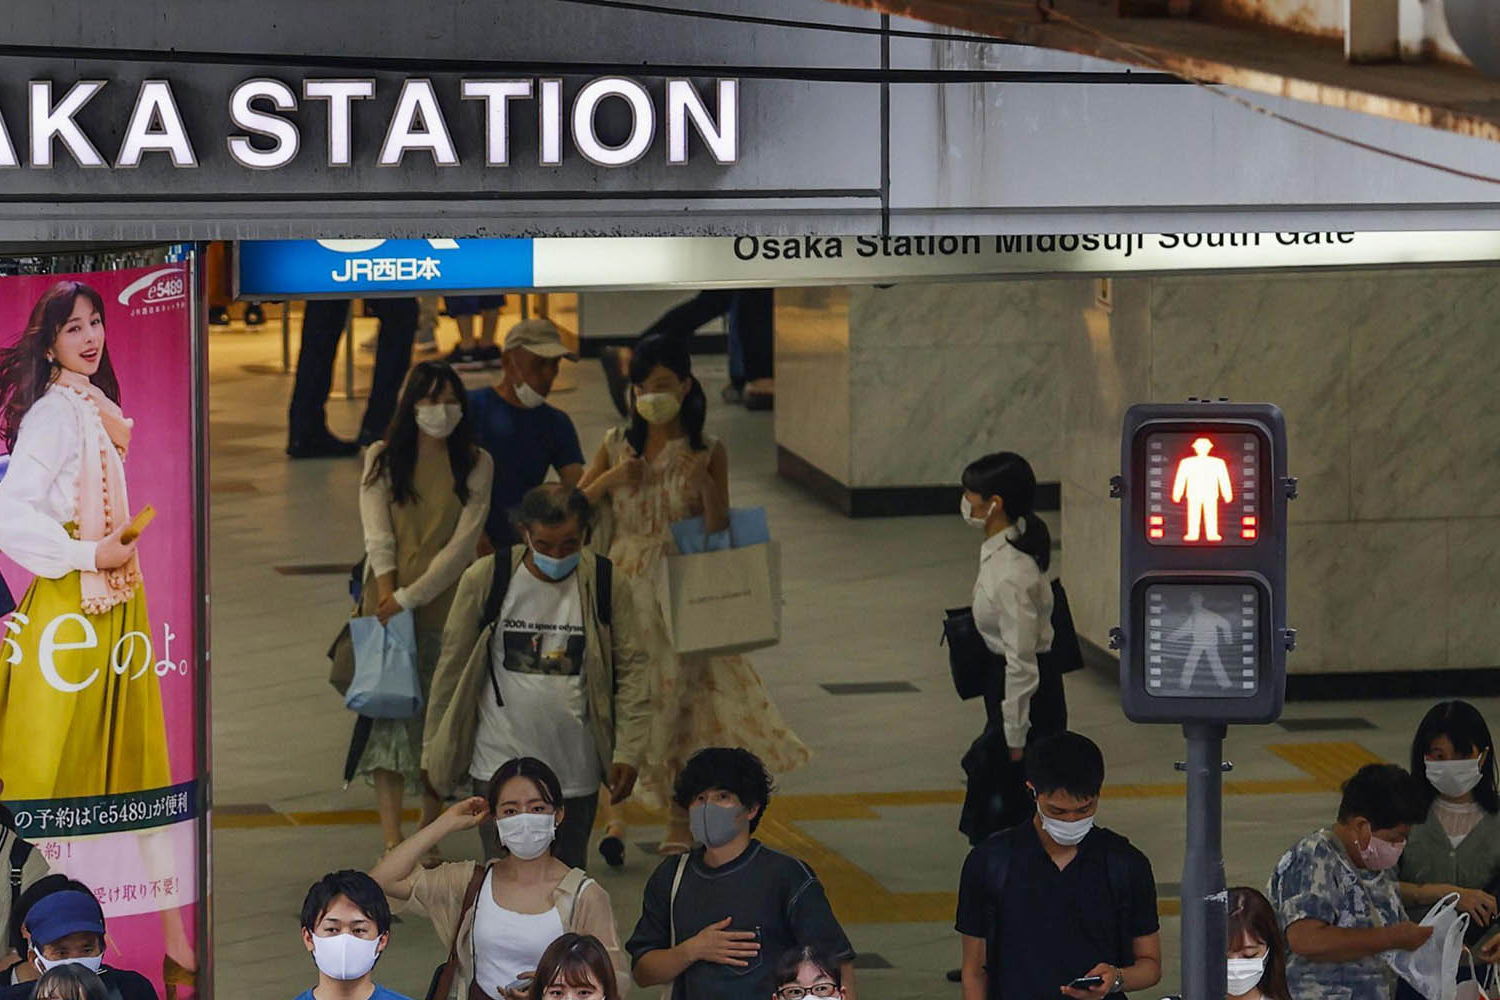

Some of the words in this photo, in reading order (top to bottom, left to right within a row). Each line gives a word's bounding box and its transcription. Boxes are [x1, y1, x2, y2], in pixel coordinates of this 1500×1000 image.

[226, 77, 740, 172] STATION
[733, 235, 843, 261] Osaka
[855, 234, 980, 258] Station
[331, 256, 442, 283] JR西日本
[147, 278, 183, 300] e5489
